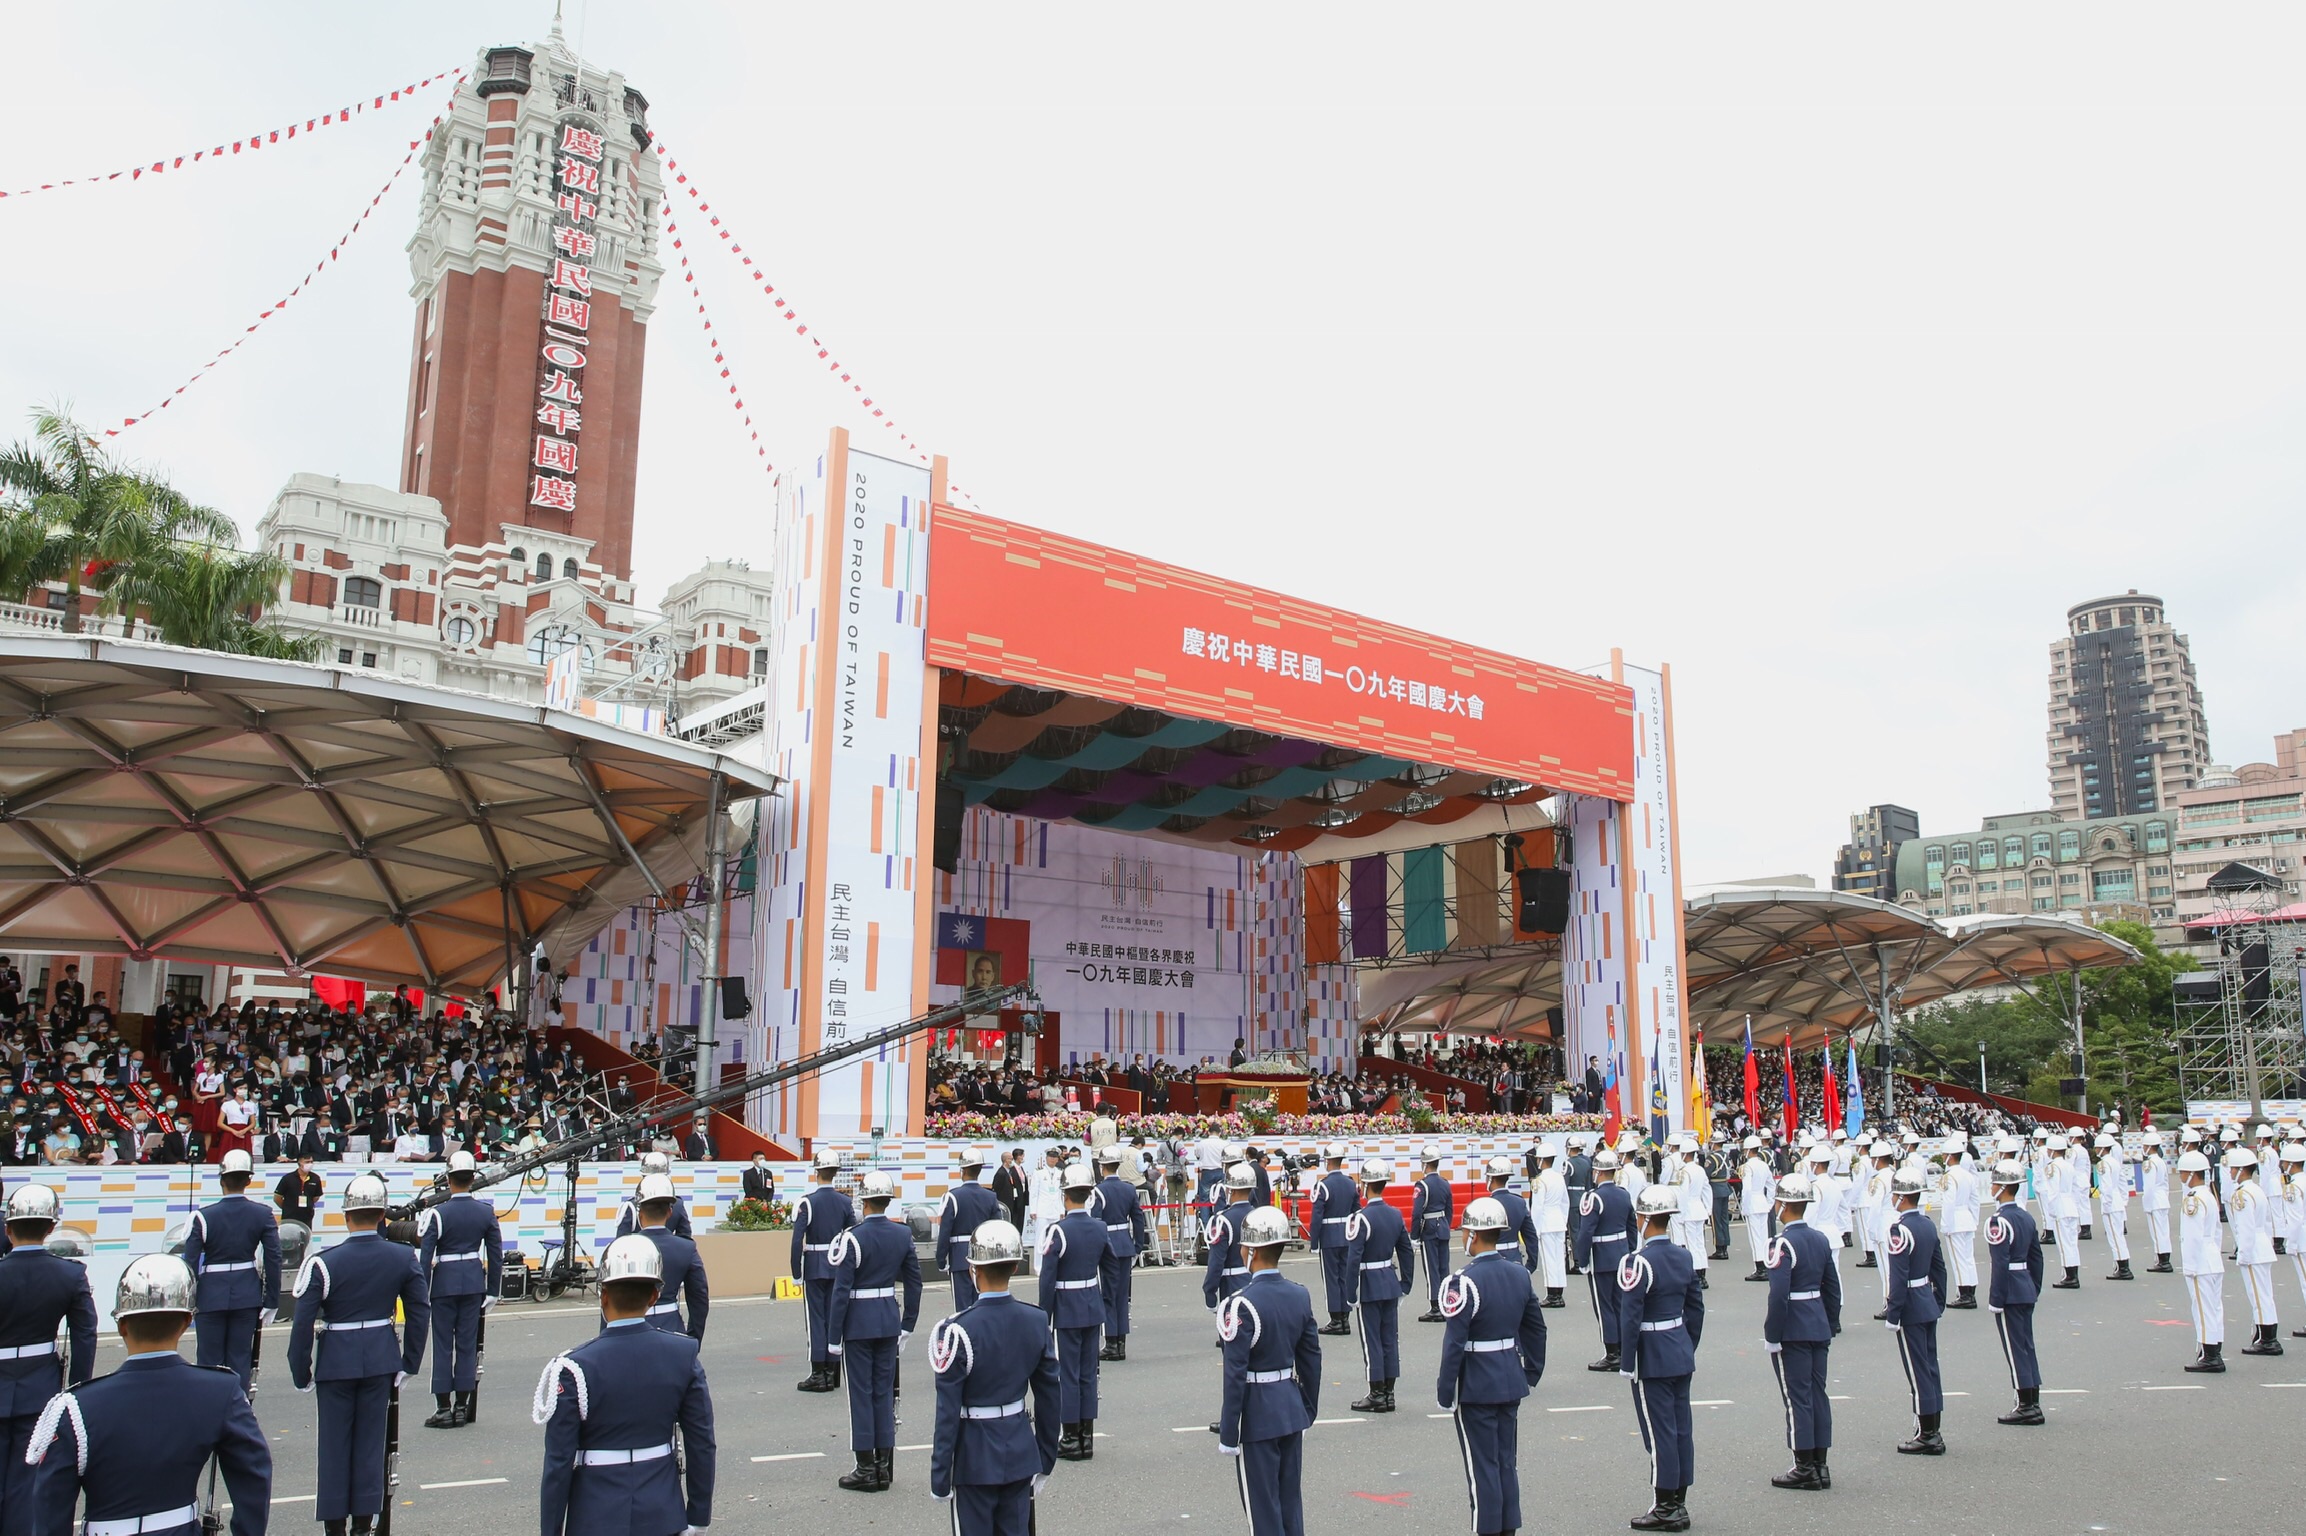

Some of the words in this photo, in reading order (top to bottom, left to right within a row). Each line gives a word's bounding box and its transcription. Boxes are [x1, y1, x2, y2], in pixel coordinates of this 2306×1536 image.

[854, 473, 867, 530] 2020
[849, 538, 863, 615] PROUD
[847, 625, 858, 653] OF
[842, 662, 857, 749] TAIWAN
[1651, 687, 1659, 726] 2020
[1653, 732, 1662, 784] PROUD
[1656, 791, 1663, 811] OF
[1659, 818, 1667, 875] TAIWAN
[1066, 941, 1195, 965] 中華民國中樞暨各界慶祝
[781, 1279, 802, 1297] 15
